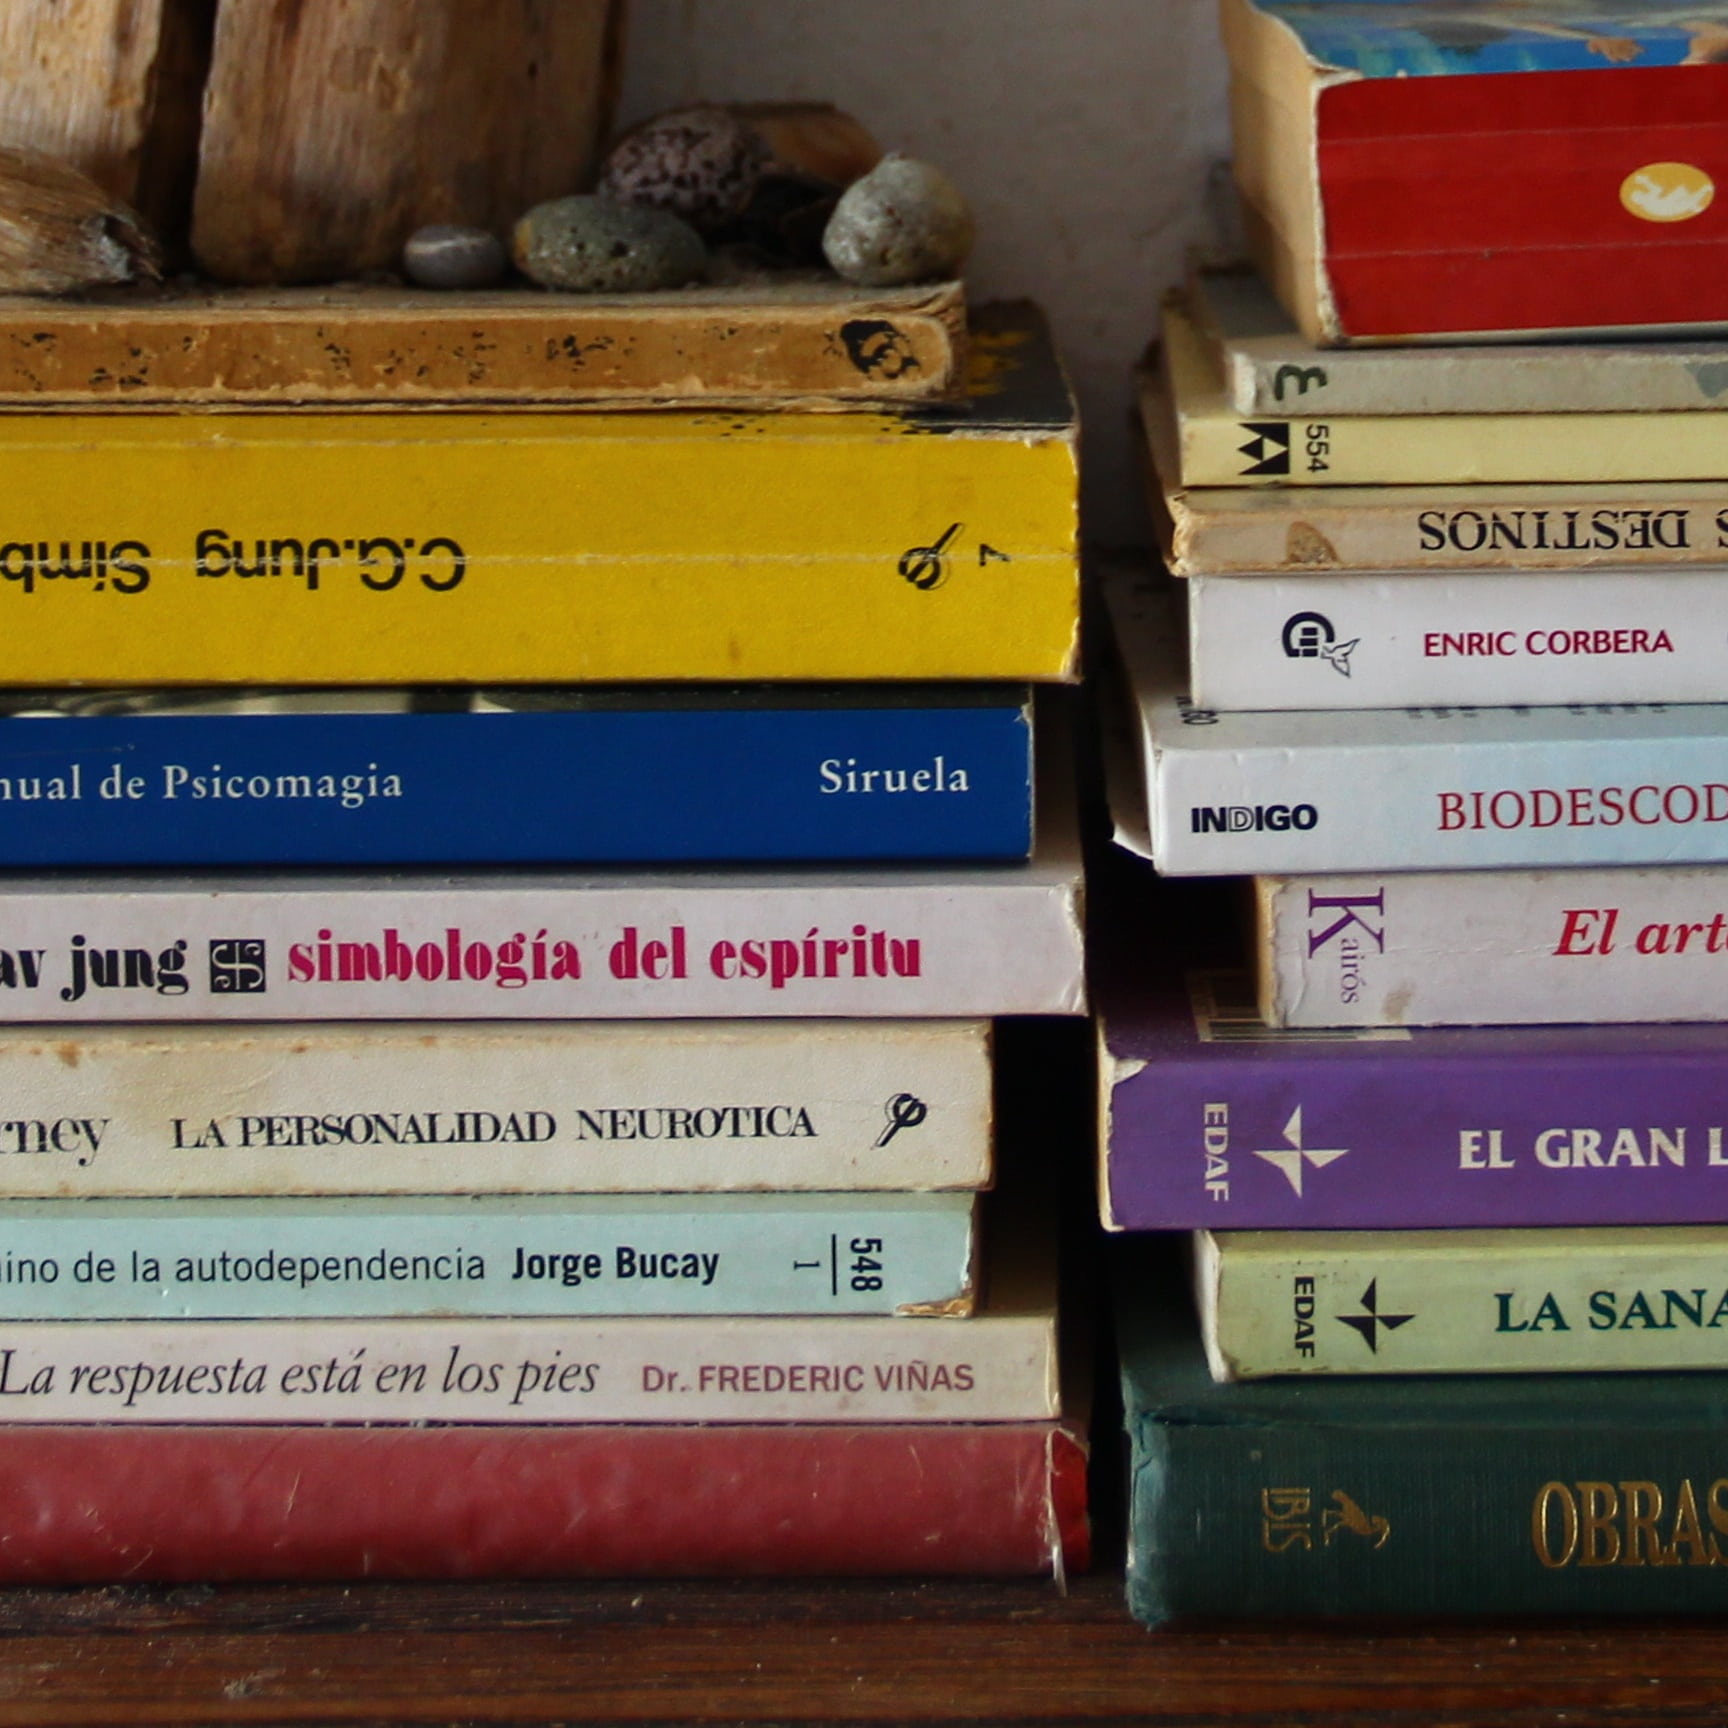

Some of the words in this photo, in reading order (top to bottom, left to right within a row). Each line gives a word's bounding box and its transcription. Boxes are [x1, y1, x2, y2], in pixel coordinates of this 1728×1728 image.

[1305, 422, 1330, 473] 554
[1418, 509, 1691, 552] DESTINOS
[1424, 630, 1517, 657] ENRIC
[1525, 629, 1674, 656] CORBERA
[99, 763, 145, 800] de
[163, 762, 403, 809] Psicomagia
[820, 755, 969, 794] Siruela
[1191, 803, 1319, 834] INDIGO
[1307, 886, 1385, 1004] Kairós
[1552, 908, 1619, 956] El
[60, 933, 190, 1001] jung
[288, 927, 582, 989] simbología
[608, 925, 688, 980] del
[709, 923, 921, 990] espíritu
[173, 1118, 227, 1149] LA
[240, 1111, 557, 1147] PERSONALIDAD
[576, 1106, 817, 1140] NEUROTICA
[1459, 1129, 1516, 1169] EL
[1534, 1127, 1686, 1169] GRAN
[1204, 1103, 1229, 1202] EDAF
[73, 1250, 116, 1284] de
[132, 1250, 161, 1283] la
[175, 1247, 485, 1289] autodependencia
[511, 1247, 602, 1287] Jorge
[616, 1246, 720, 1286] Bucay
[849, 1238, 883, 1292] 548
[1294, 1276, 1316, 1358] EDAF
[1494, 1292, 1571, 1333] LA
[69, 1357, 268, 1405] respuesta
[280, 1347, 366, 1395] está
[375, 1363, 427, 1394] en
[442, 1345, 504, 1394] los
[509, 1350, 600, 1406] pies
[642, 1365, 687, 1393] Dr.
[699, 1364, 865, 1393] FREDERIC
[874, 1359, 975, 1392] VIÑAS
[1261, 1486, 1312, 1551] IBIS
